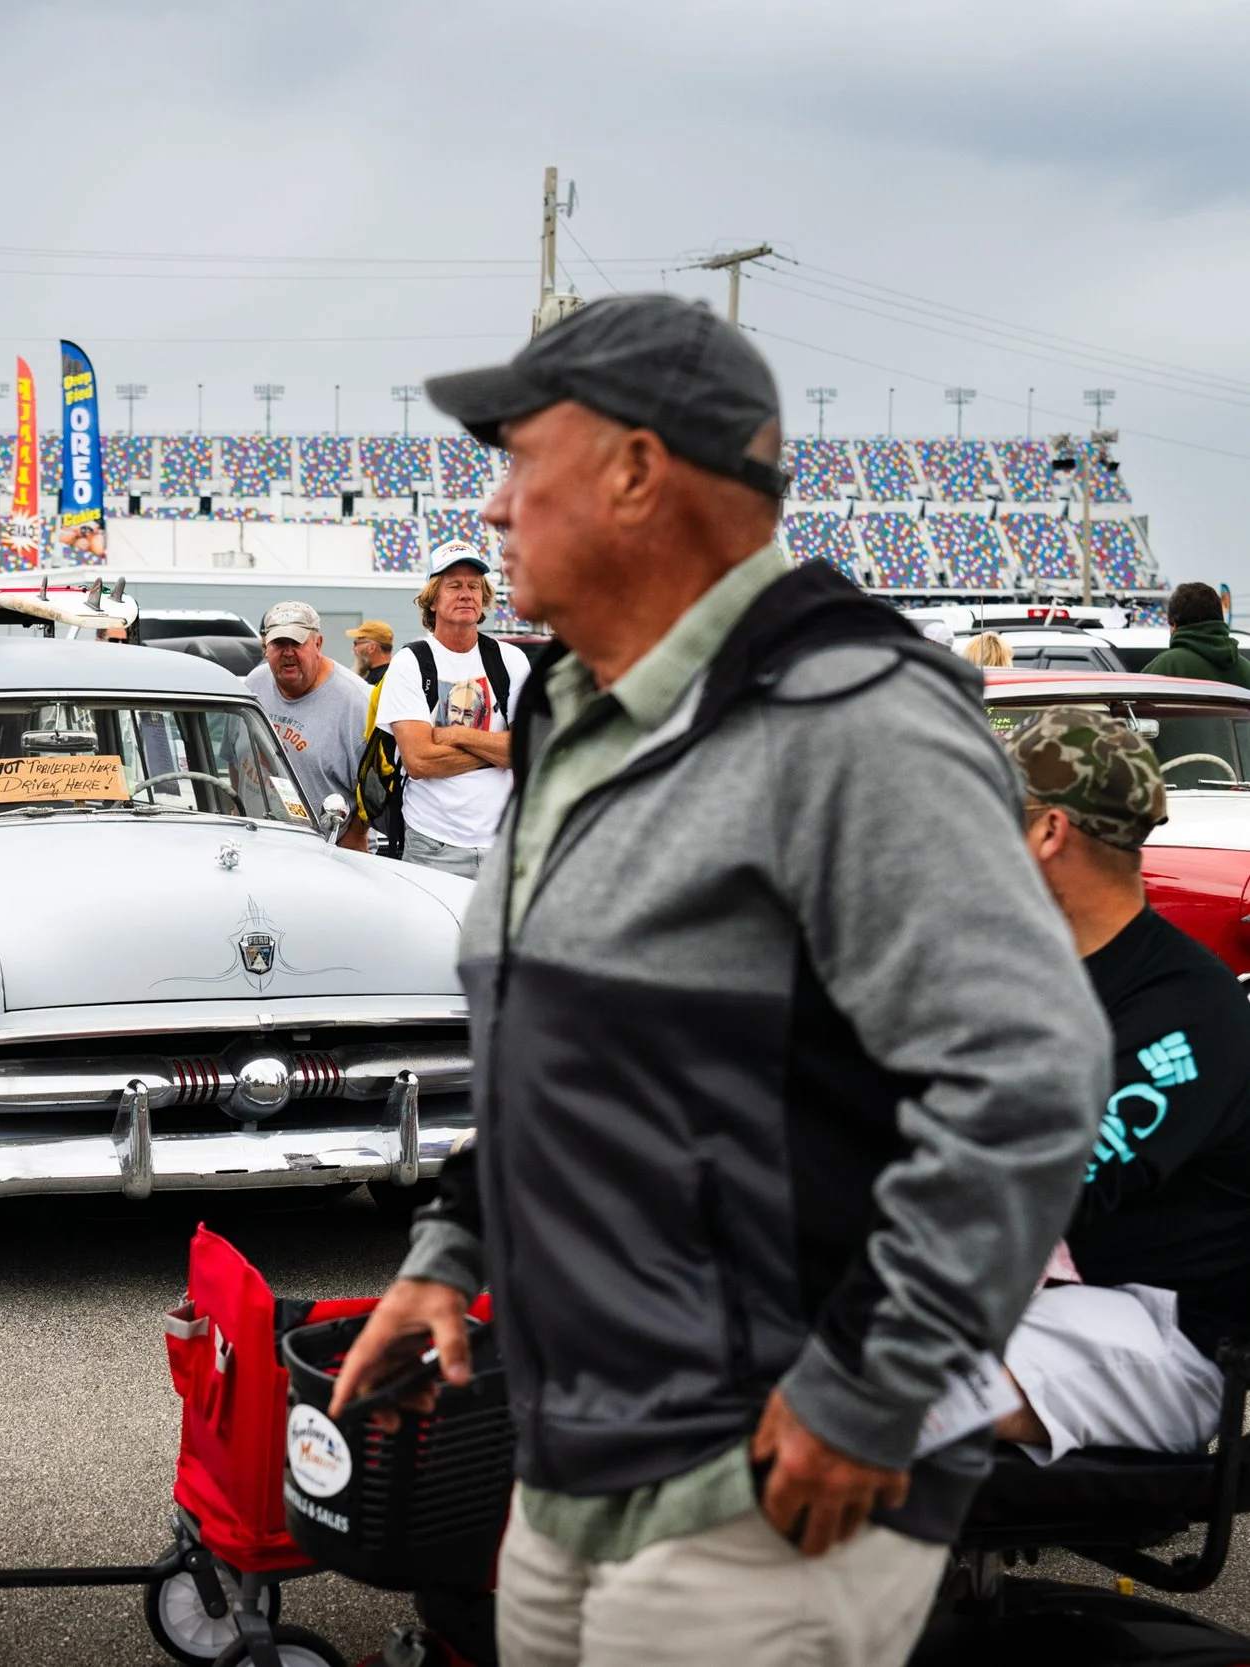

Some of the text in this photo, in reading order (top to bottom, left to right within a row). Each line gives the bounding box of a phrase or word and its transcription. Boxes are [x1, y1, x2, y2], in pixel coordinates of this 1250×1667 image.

[70, 407, 93, 504] OREO
[282, 726, 308, 752] DOG
[86, 759, 119, 777] HERE
[248, 936, 269, 945] FORD
